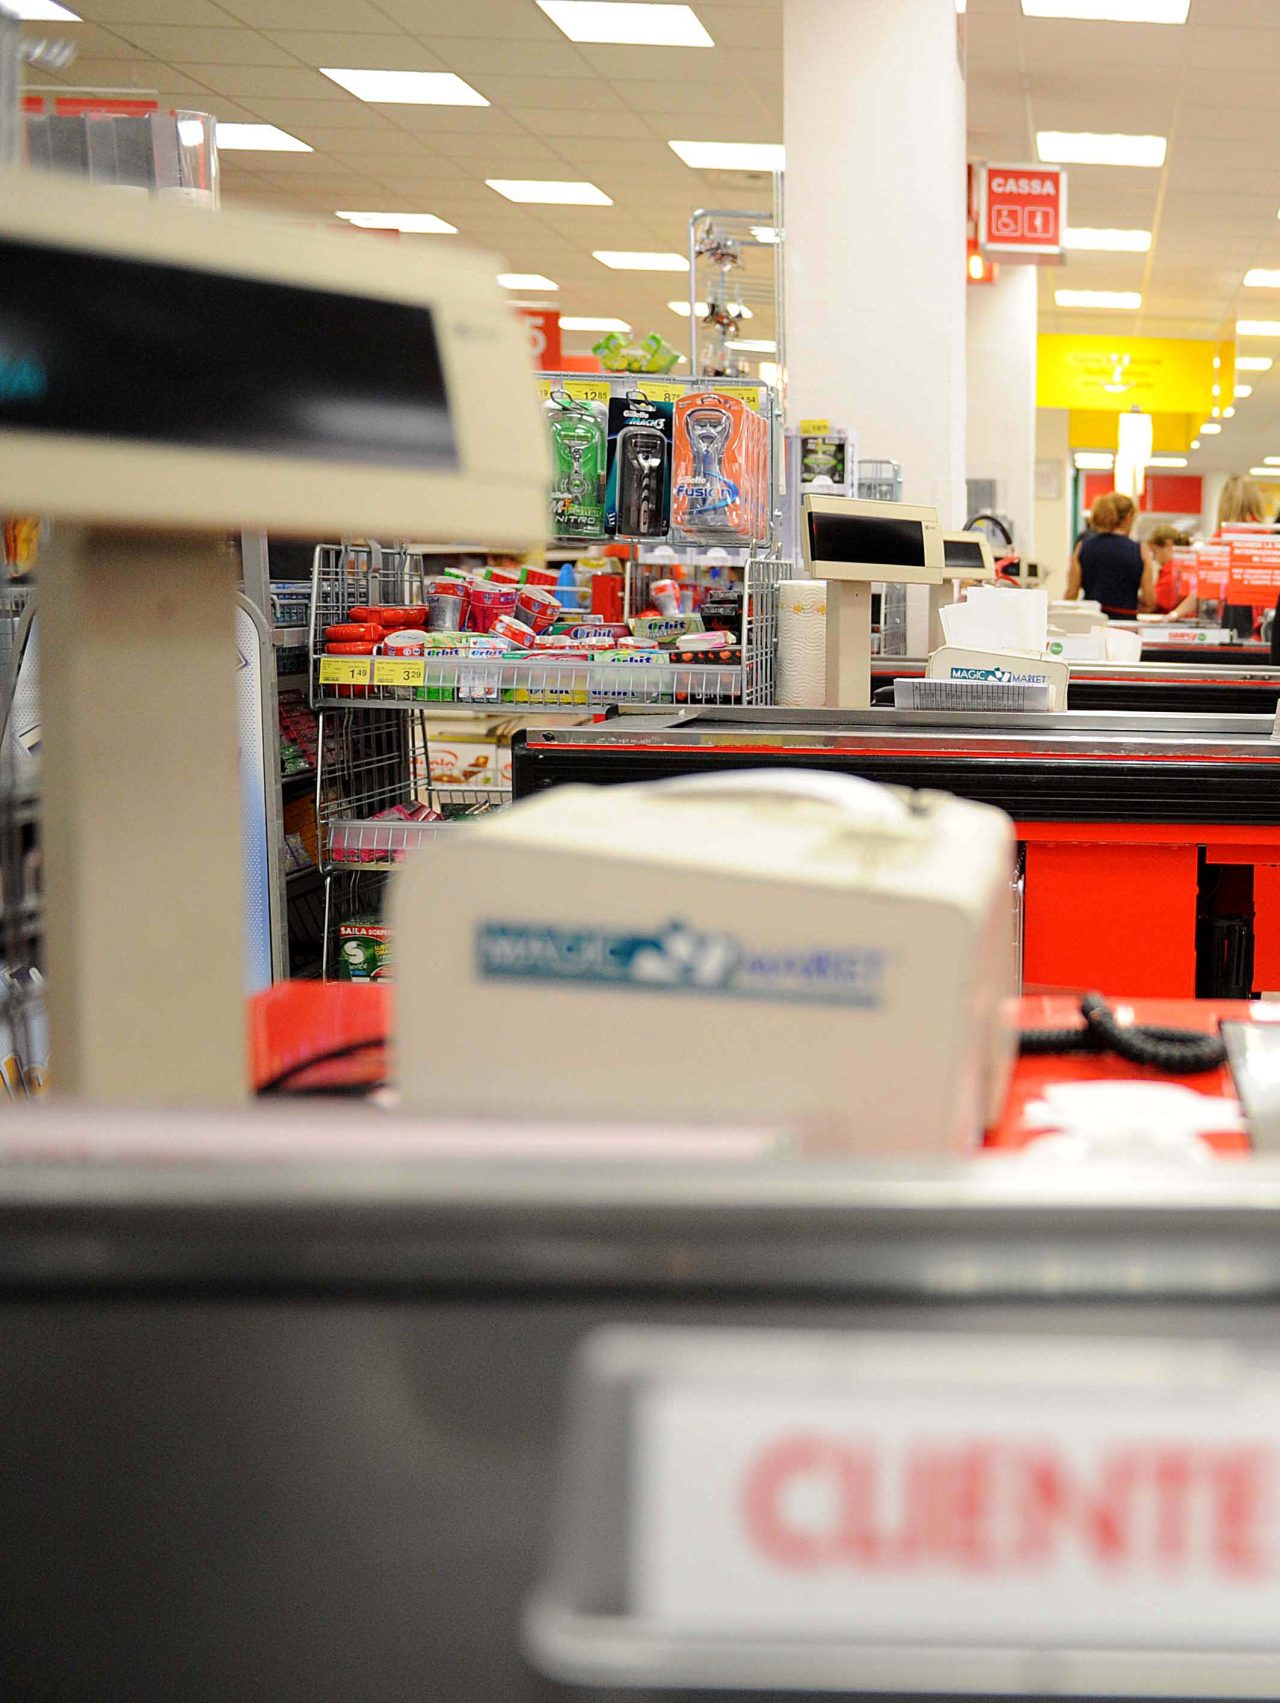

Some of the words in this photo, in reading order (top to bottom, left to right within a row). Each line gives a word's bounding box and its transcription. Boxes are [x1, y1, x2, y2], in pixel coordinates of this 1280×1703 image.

[991, 177, 1056, 196] CASSA
[555, 515, 596, 524] NITRO
[648, 620, 686, 630] Orbit
[573, 628, 612, 638] Orbit
[427, 648, 460, 657] Orbit
[952, 669, 986, 680] MAGIC
[340, 926, 367, 935] SAILA
[742, 1430, 1275, 1583] CLIENTE
